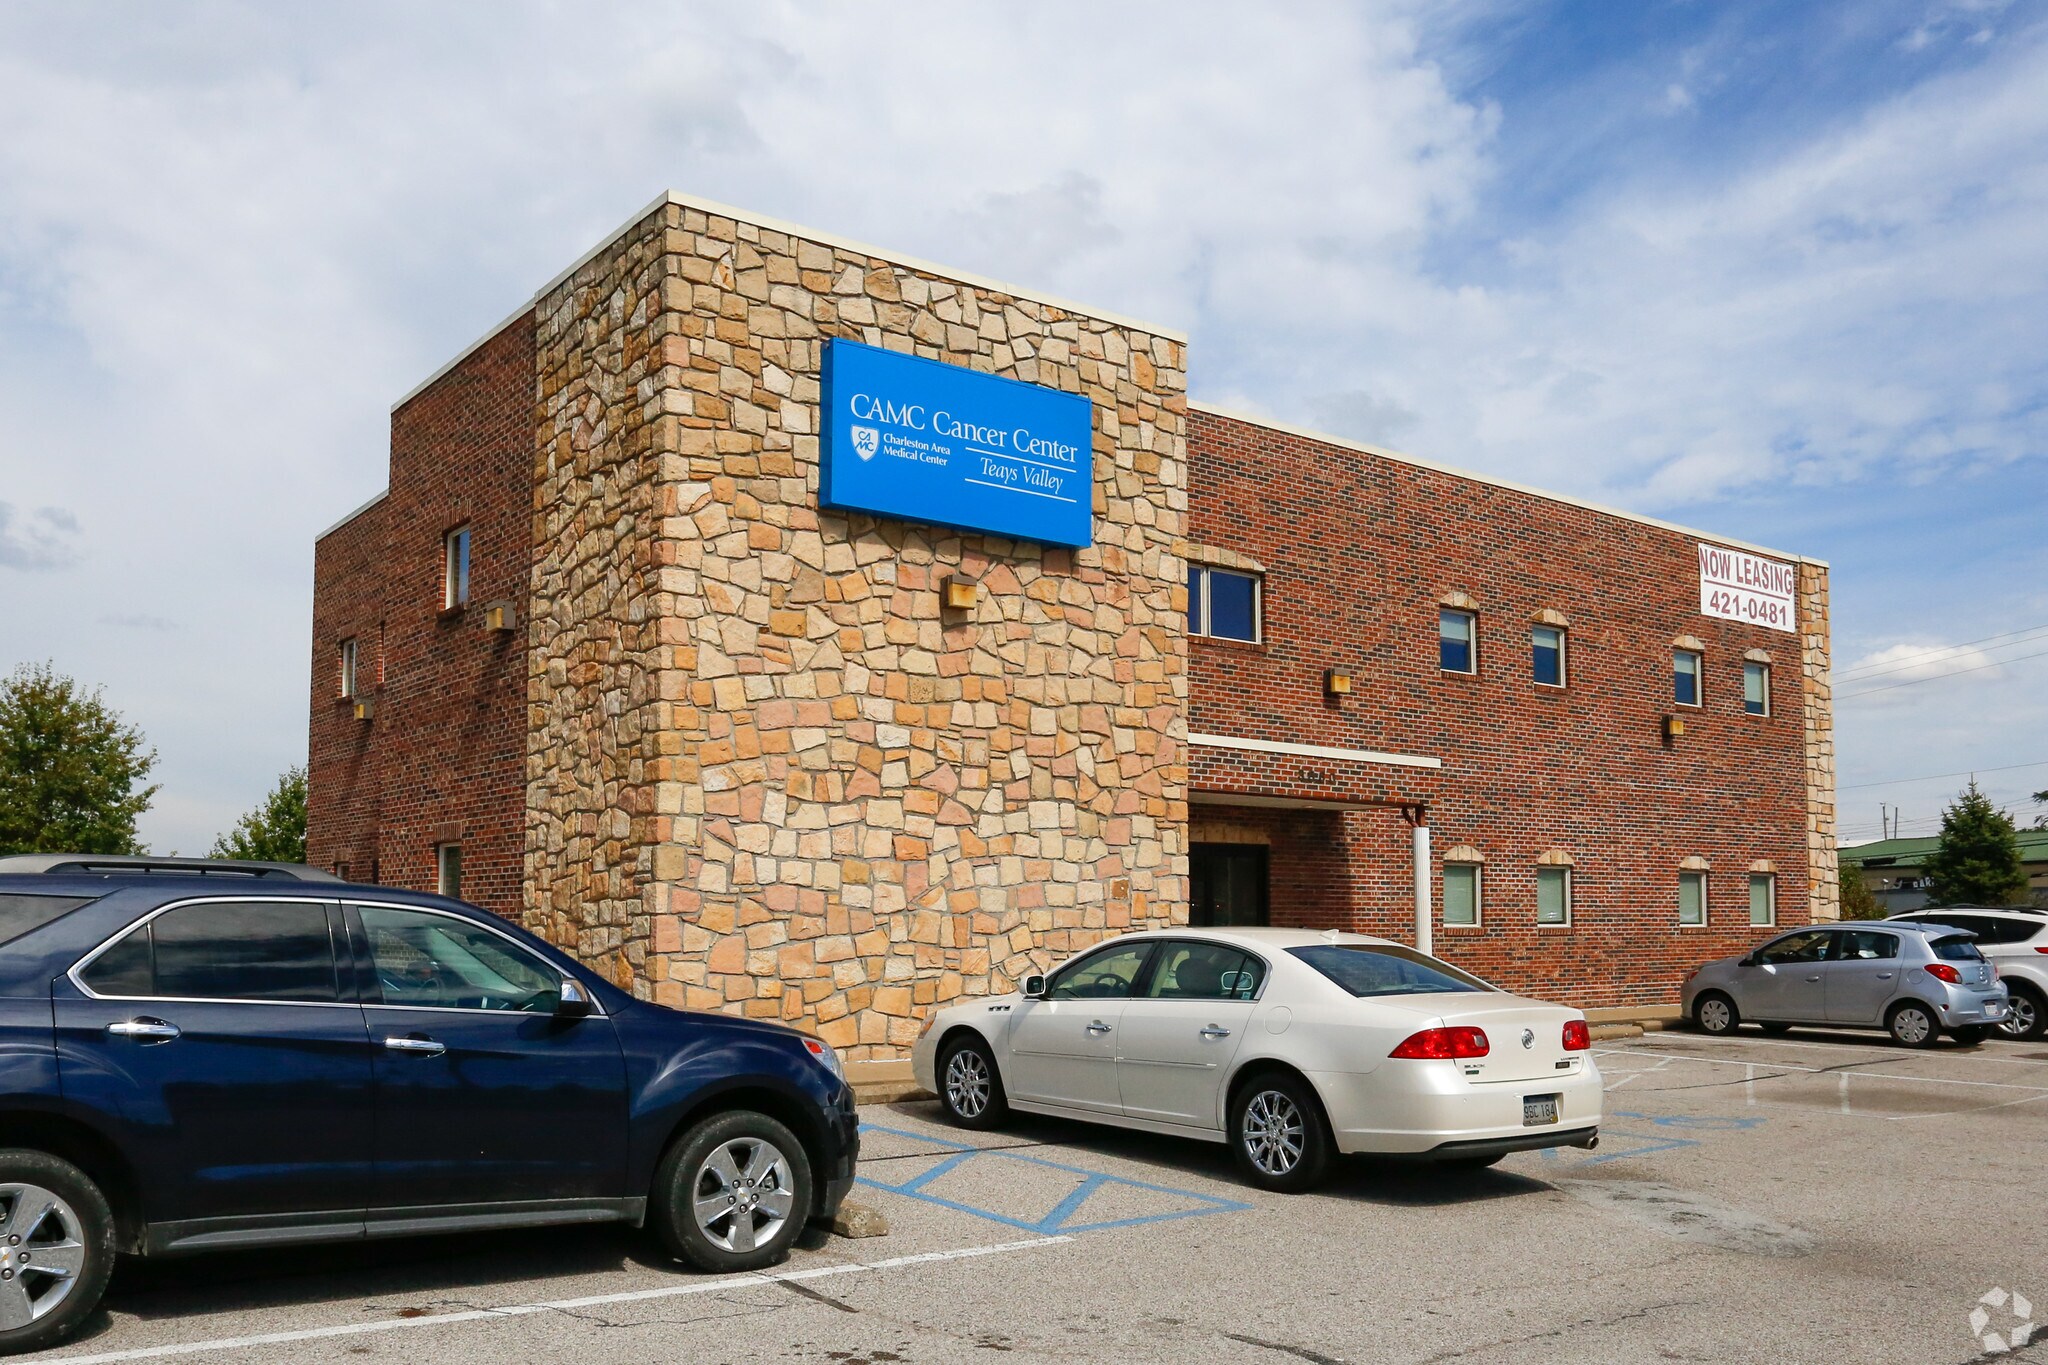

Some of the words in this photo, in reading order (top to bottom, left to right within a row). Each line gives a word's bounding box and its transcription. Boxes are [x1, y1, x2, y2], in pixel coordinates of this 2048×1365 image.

[850, 393, 925, 430] CAMC
[932, 411, 1007, 447] Cancer
[1013, 429, 1078, 462] Center
[858, 431, 871, 441] CA
[883, 433, 929, 451] Charleston
[931, 443, 951, 456] Area
[883, 445, 918, 461] Medical
[919, 452, 948, 466] Center
[980, 457, 1018, 484] Teays
[1023, 466, 1063, 494] Valley
[1700, 547, 1731, 580] NOW
[1736, 556, 1793, 595] LEASING
[1710, 590, 1786, 626] 421-0481
